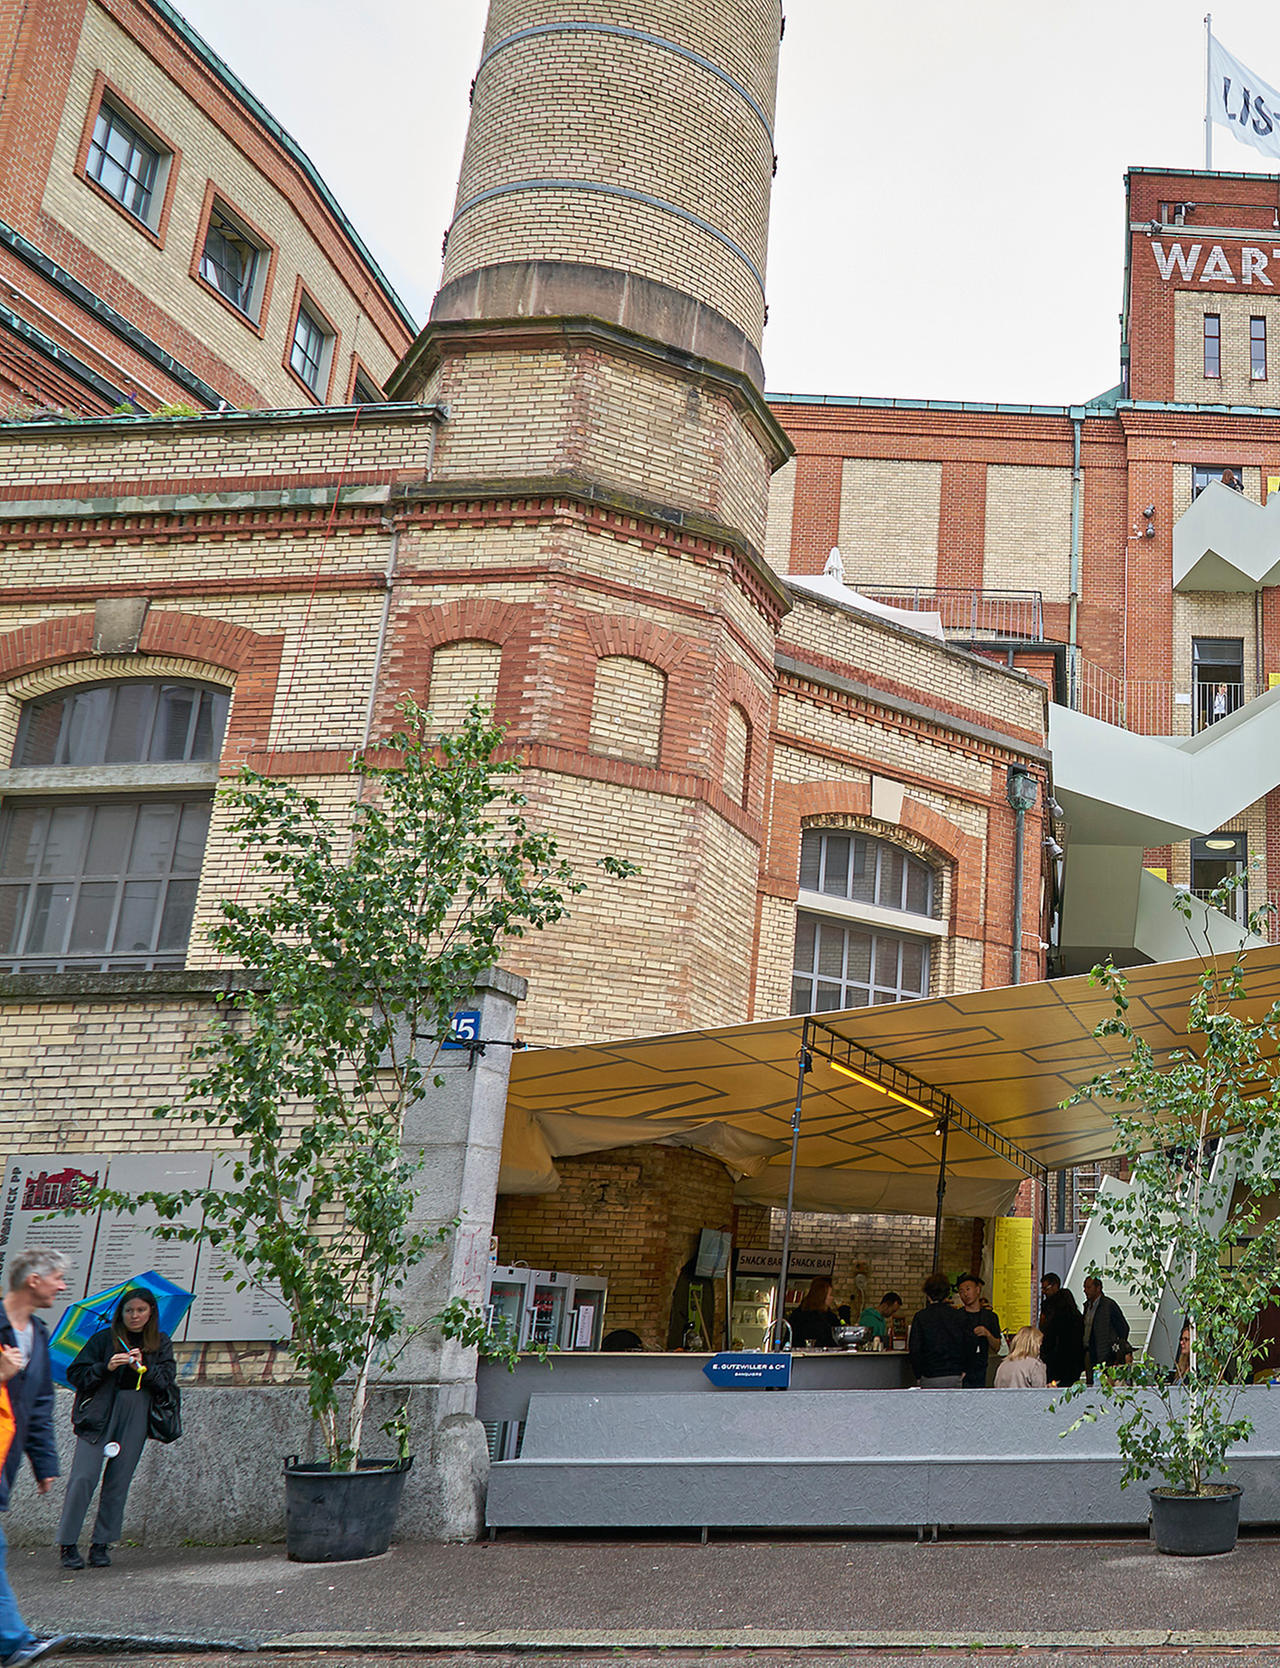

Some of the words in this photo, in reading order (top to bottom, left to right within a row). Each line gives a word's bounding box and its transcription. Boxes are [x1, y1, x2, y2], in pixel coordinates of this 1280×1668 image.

[740, 1255, 767, 1266] SNACK
[768, 1257, 783, 1267] BAR
[791, 1257, 816, 1268] SNACK
[816, 1259, 832, 1269] BAR
